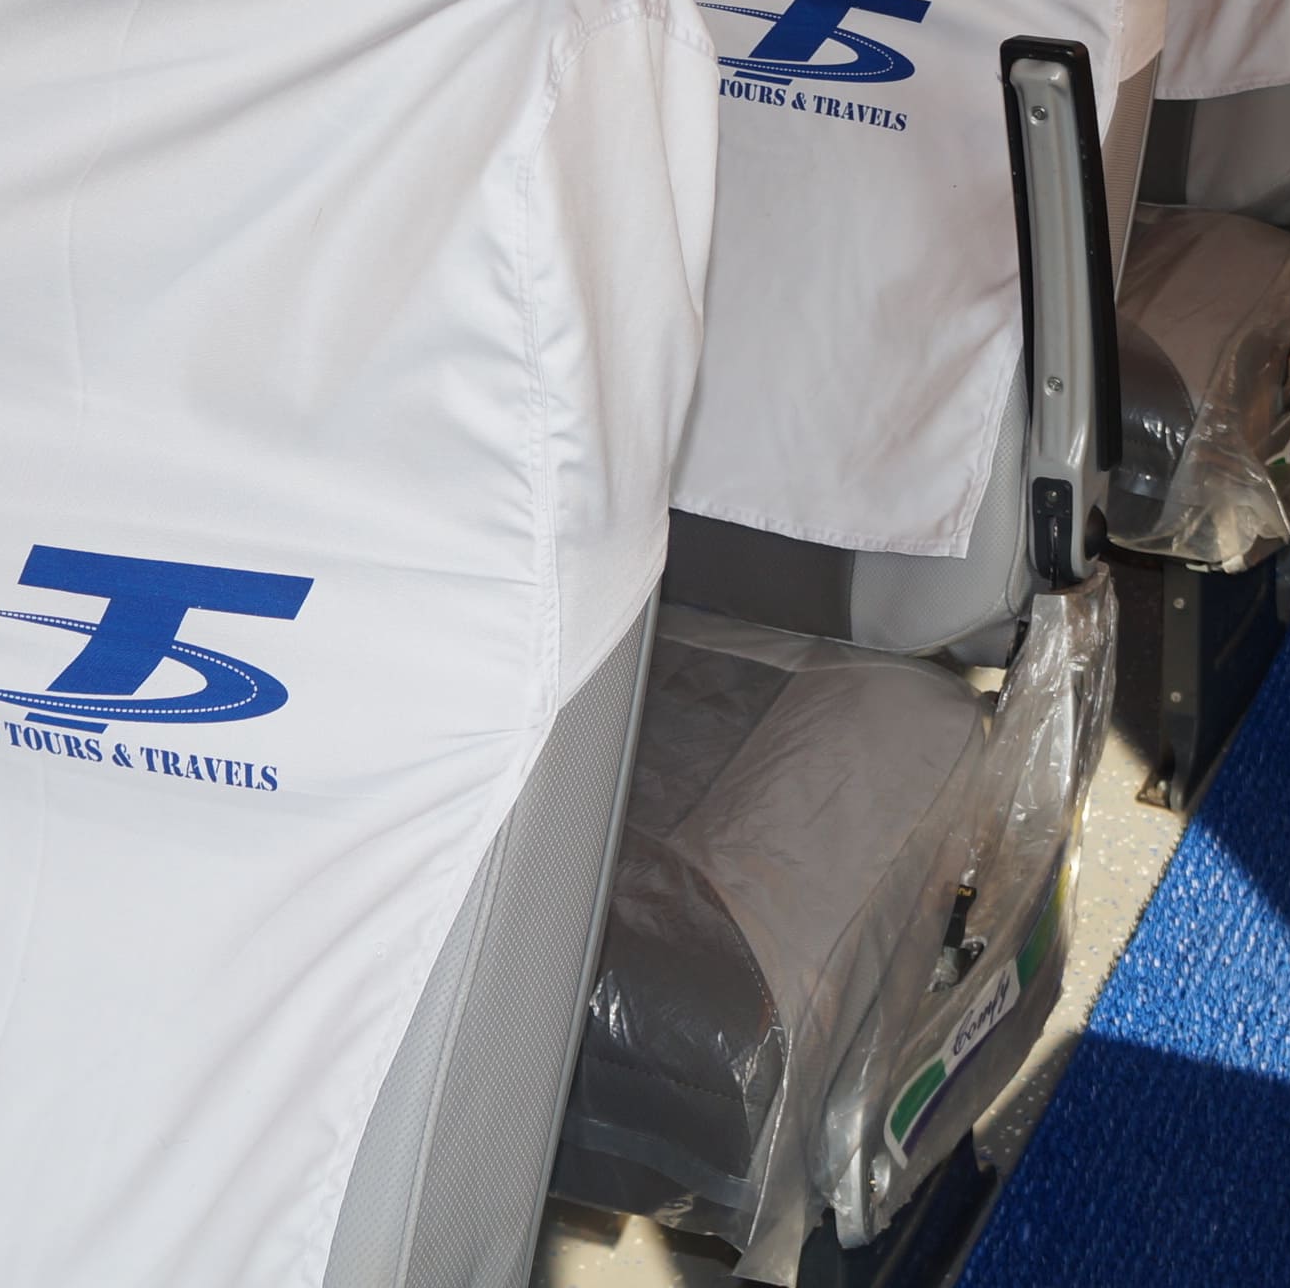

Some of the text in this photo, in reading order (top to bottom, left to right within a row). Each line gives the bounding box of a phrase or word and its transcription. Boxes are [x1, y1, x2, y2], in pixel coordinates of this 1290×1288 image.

[719, 78, 908, 132] TOURS & TRAVELS
[3, 721, 103, 763] TOURS
[111, 742, 134, 769] &
[139, 746, 278, 792] TRAVELS
